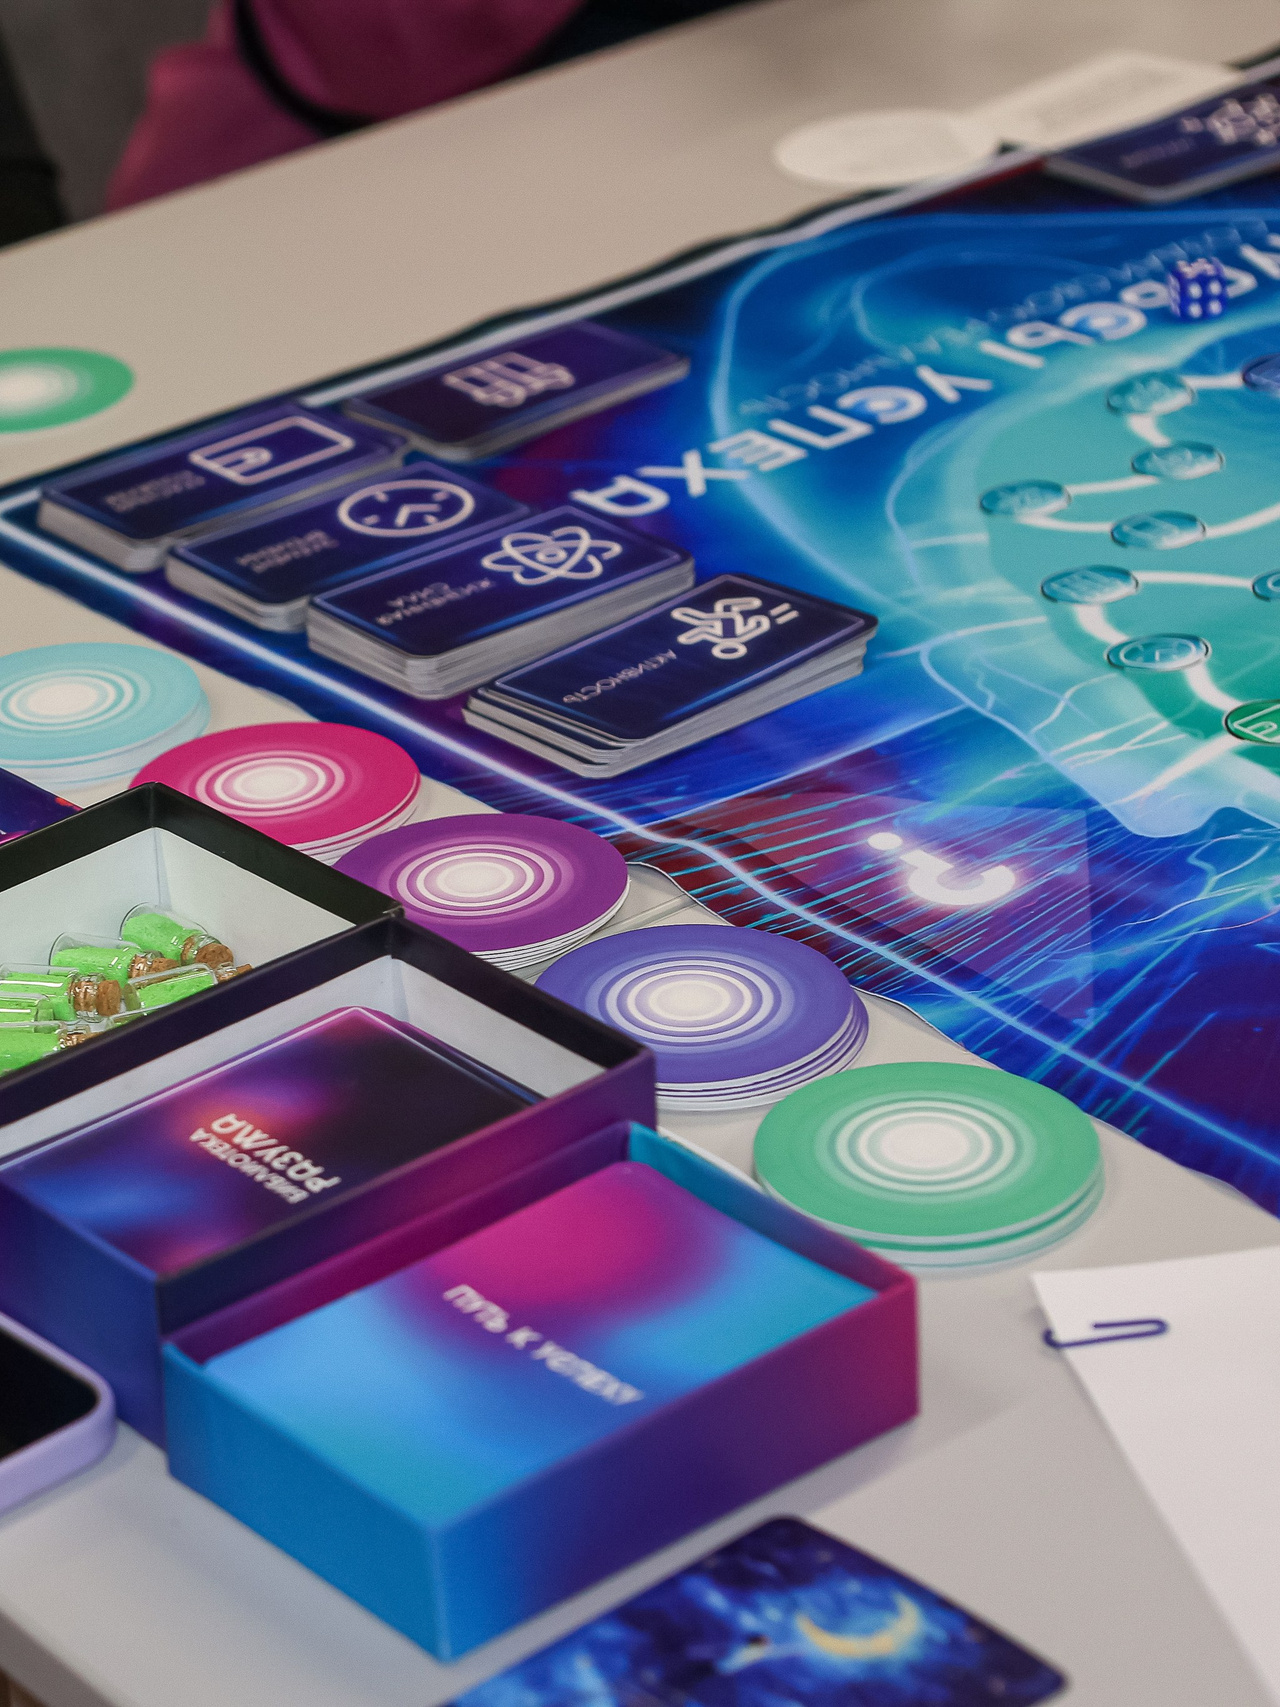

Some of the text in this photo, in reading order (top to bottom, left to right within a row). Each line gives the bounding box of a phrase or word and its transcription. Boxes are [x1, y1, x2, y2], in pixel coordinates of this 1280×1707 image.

[570, 365, 993, 515] УСПЕХА
[562, 649, 677, 704] АКТИВНОСТЬ
[189, 1127, 310, 1205] БИБЛИОТЕКА
[211, 1113, 342, 1194] РАЗУМА
[442, 1284, 509, 1334] ПУТЬ
